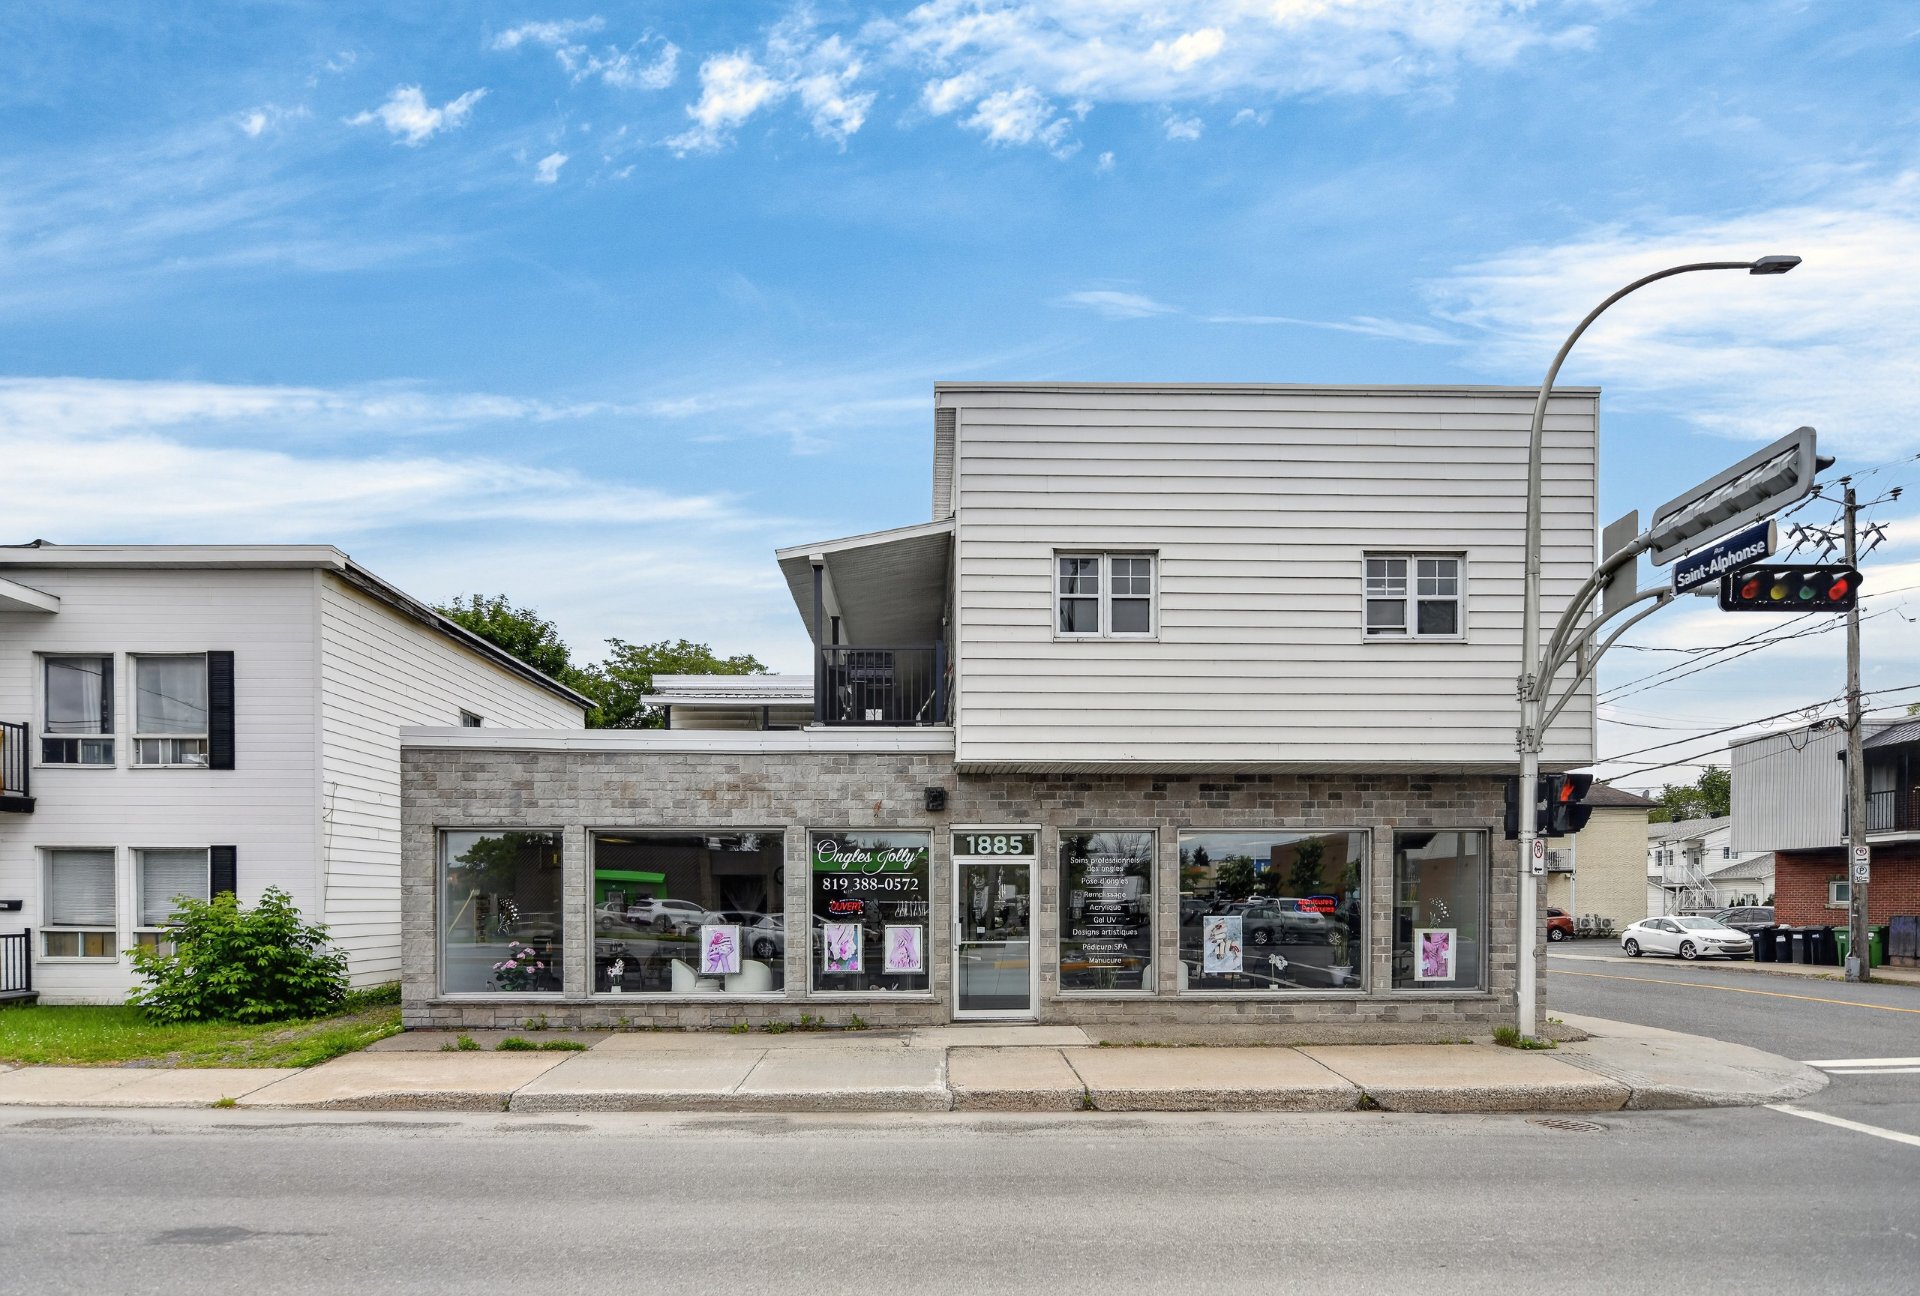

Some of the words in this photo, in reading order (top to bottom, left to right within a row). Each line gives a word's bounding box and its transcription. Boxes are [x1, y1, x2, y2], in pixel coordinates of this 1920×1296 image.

[1713, 546, 1724, 554] Rue
[1677, 540, 1766, 587] Saint-Alphonse
[966, 835, 1023, 855] 1885
[817, 839, 872, 870] Ongles
[1070, 856, 1088, 864] Soins
[1090, 856, 1140, 866] professionnels
[1086, 864, 1099, 872] des
[1101, 864, 1124, 874] ongles
[822, 877, 848, 891] 819
[853, 877, 919, 891] 388-0572
[1099, 877, 1129, 886] d'ongles
[1084, 891, 1127, 899] Remplissage
[830, 901, 862, 912] OUVERT
[1089, 904, 1122, 912] Acrylique
[1093, 916, 1105, 924] Gel
[1106, 916, 1117, 924] UV
[1072, 928, 1099, 937] Designs
[1101, 929, 1138, 937] artistiques
[1113, 943, 1128, 951] SPA
[1088, 956, 1122, 964] Manucure
